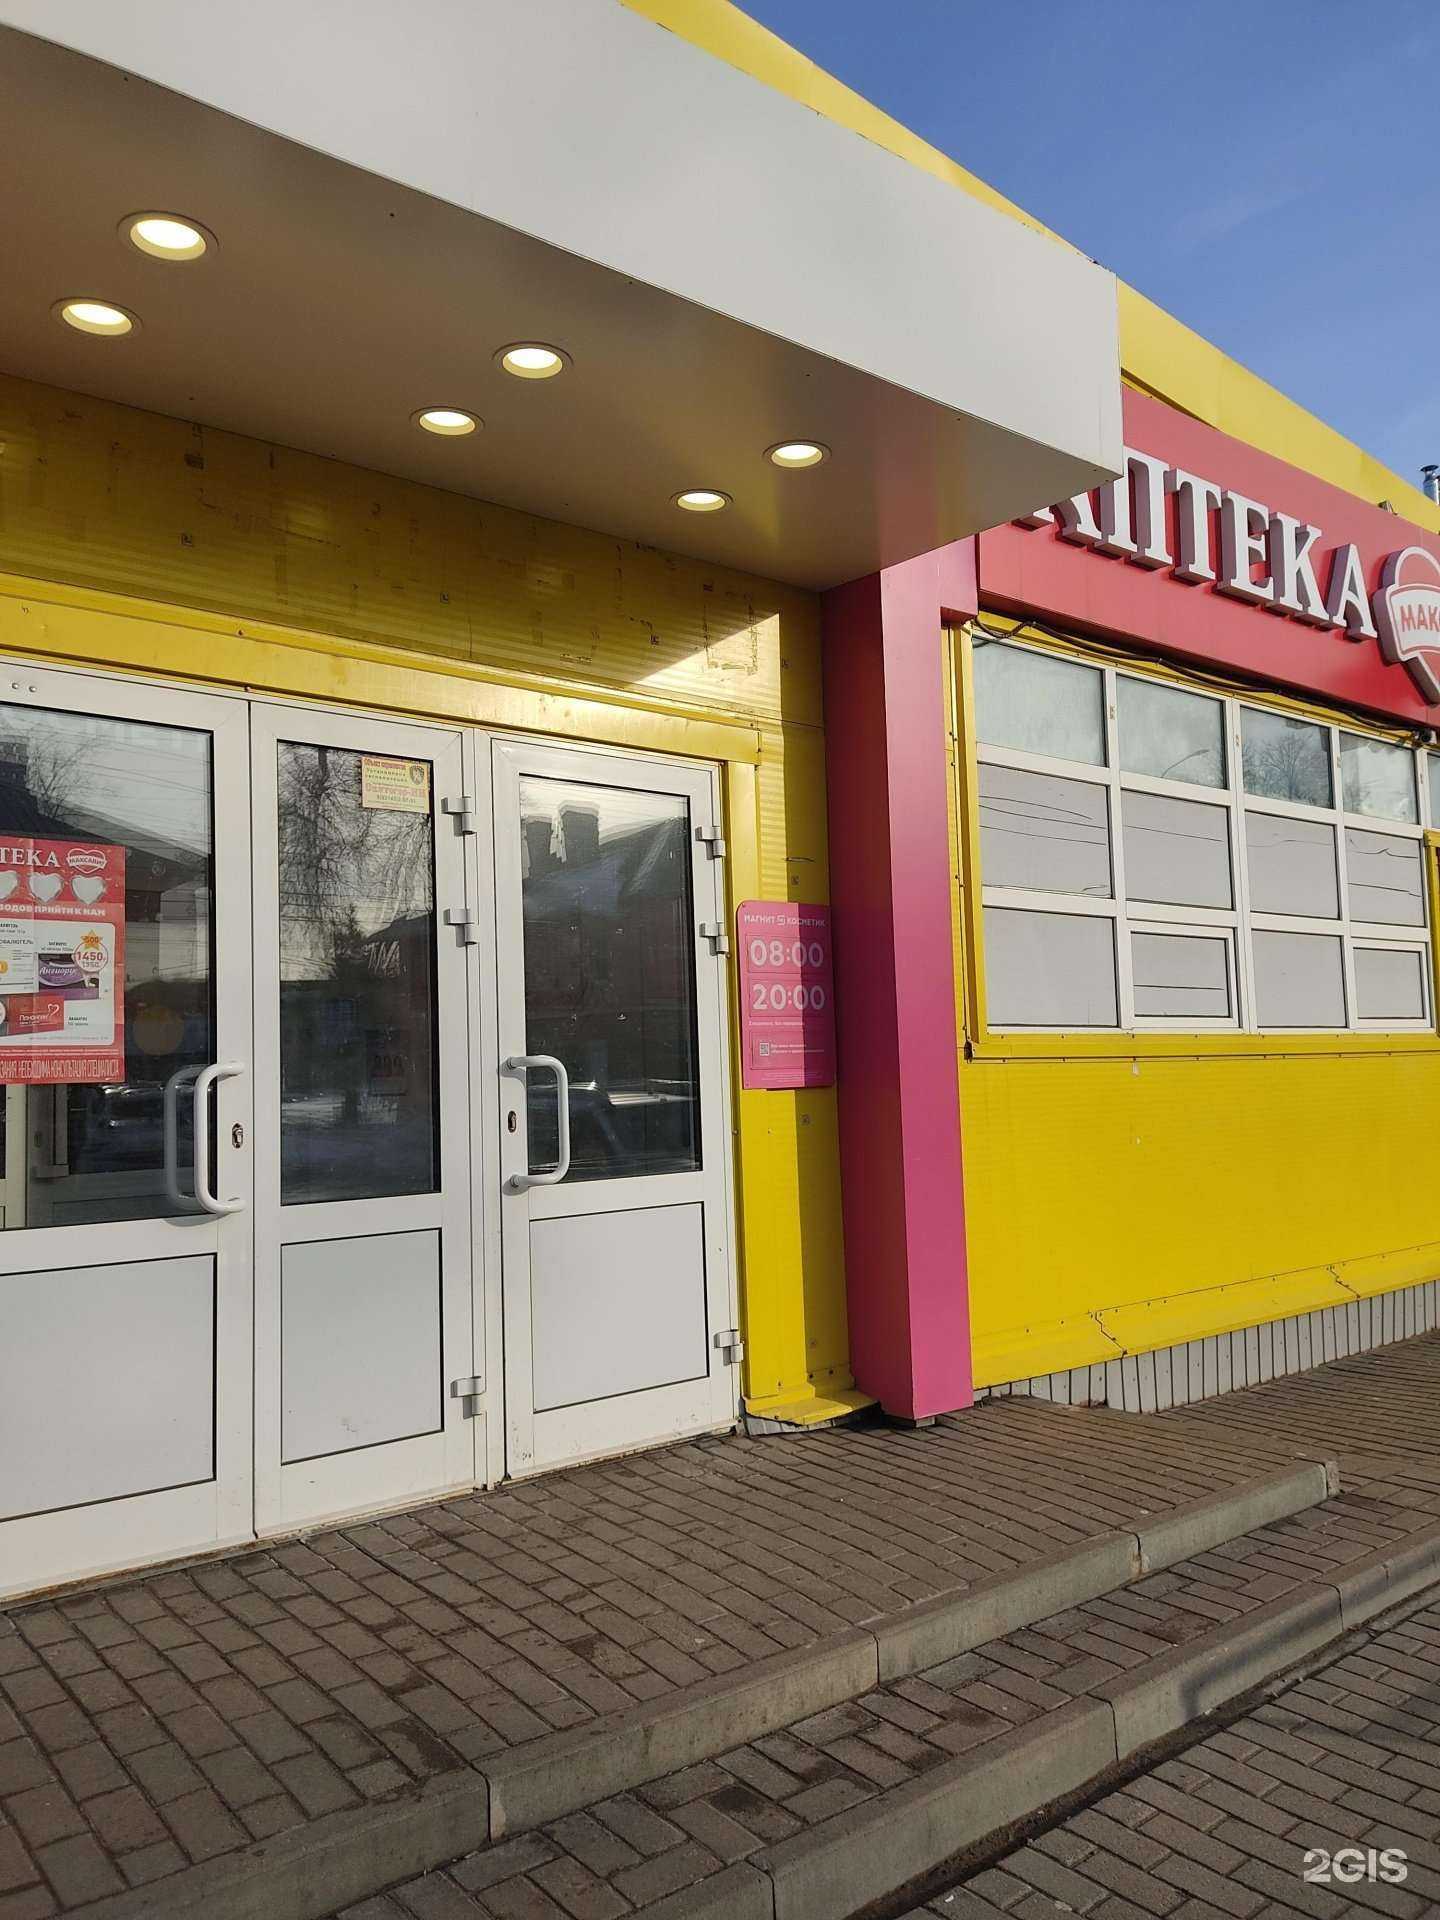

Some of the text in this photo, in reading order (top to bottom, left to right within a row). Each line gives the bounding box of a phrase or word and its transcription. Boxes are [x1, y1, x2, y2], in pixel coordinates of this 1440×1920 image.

[1399, 603, 1440, 633] МАК
[750, 939, 824, 968] 08:00
[752, 983, 825, 1011] 20:00
